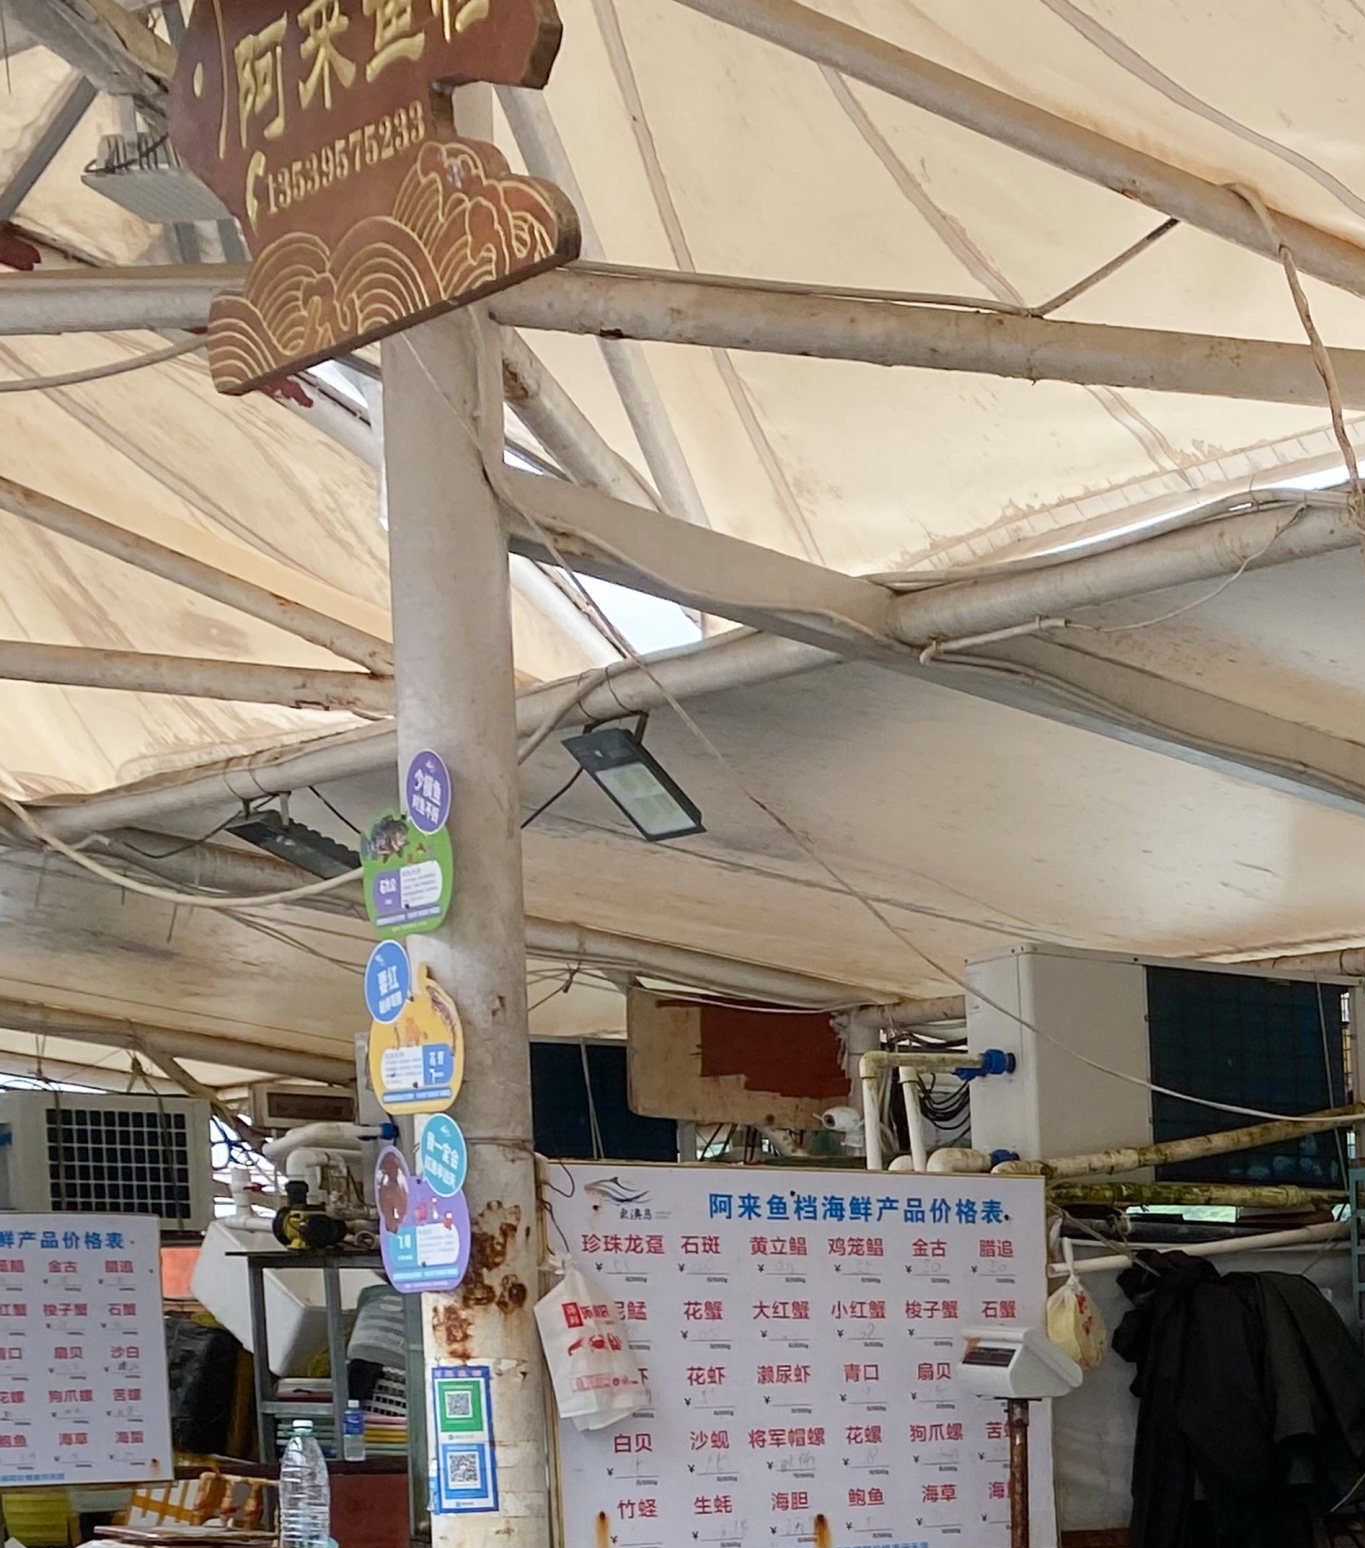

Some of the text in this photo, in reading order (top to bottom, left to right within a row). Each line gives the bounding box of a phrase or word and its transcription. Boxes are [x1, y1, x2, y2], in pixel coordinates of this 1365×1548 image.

[263, 100, 427, 214] 13539575233
[708, 1193, 1004, 1225] 阿来鱼档海鲜产品价格表
[682, 1234, 719, 1255] 石斑
[751, 1236, 807, 1257] 黄立鲳
[912, 1238, 947, 1258] 金古
[685, 1300, 723, 1322] 花蟹
[756, 1299, 809, 1320] 大红蟹
[835, 1300, 886, 1320] 小红蟹
[906, 1299, 958, 1319] 梭子蟹
[984, 1300, 1017, 1319] 石蟹
[688, 1362, 951, 1385] 花虾 濑尿虾 青口 扇贝
[614, 1432, 653, 1456] 白贝
[693, 1430, 728, 1450] 沙蚬
[748, 1427, 825, 1447] 将军帽螺
[848, 1425, 882, 1444] 花螺
[910, 1422, 963, 1441] 狗爪螺
[695, 1495, 732, 1515] 生蚝
[773, 1491, 808, 1511] 海胆
[848, 1488, 884, 1507] 鲍鱼
[923, 1483, 956, 1503] 海草
